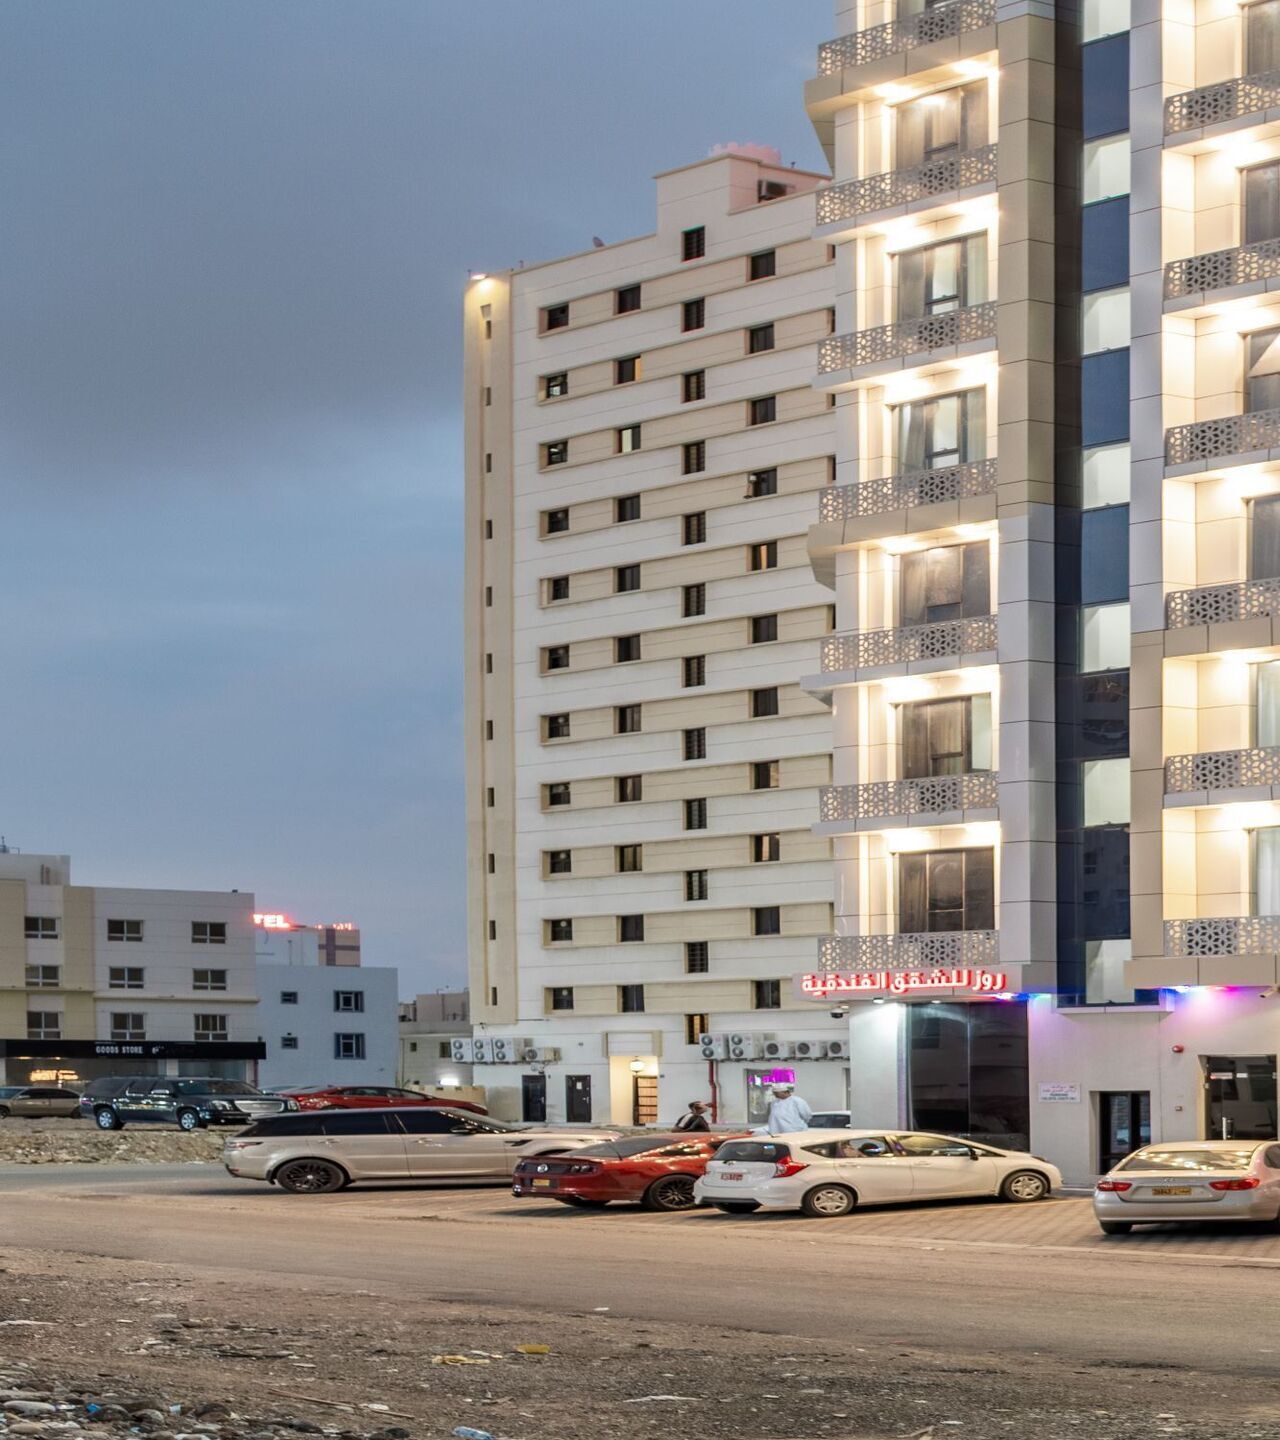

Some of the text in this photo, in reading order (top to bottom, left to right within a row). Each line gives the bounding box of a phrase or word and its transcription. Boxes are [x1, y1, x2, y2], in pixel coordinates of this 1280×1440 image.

[801, 968, 1006, 997] روز للشقق الفندقية
[121, 1045, 144, 1054] STORE
